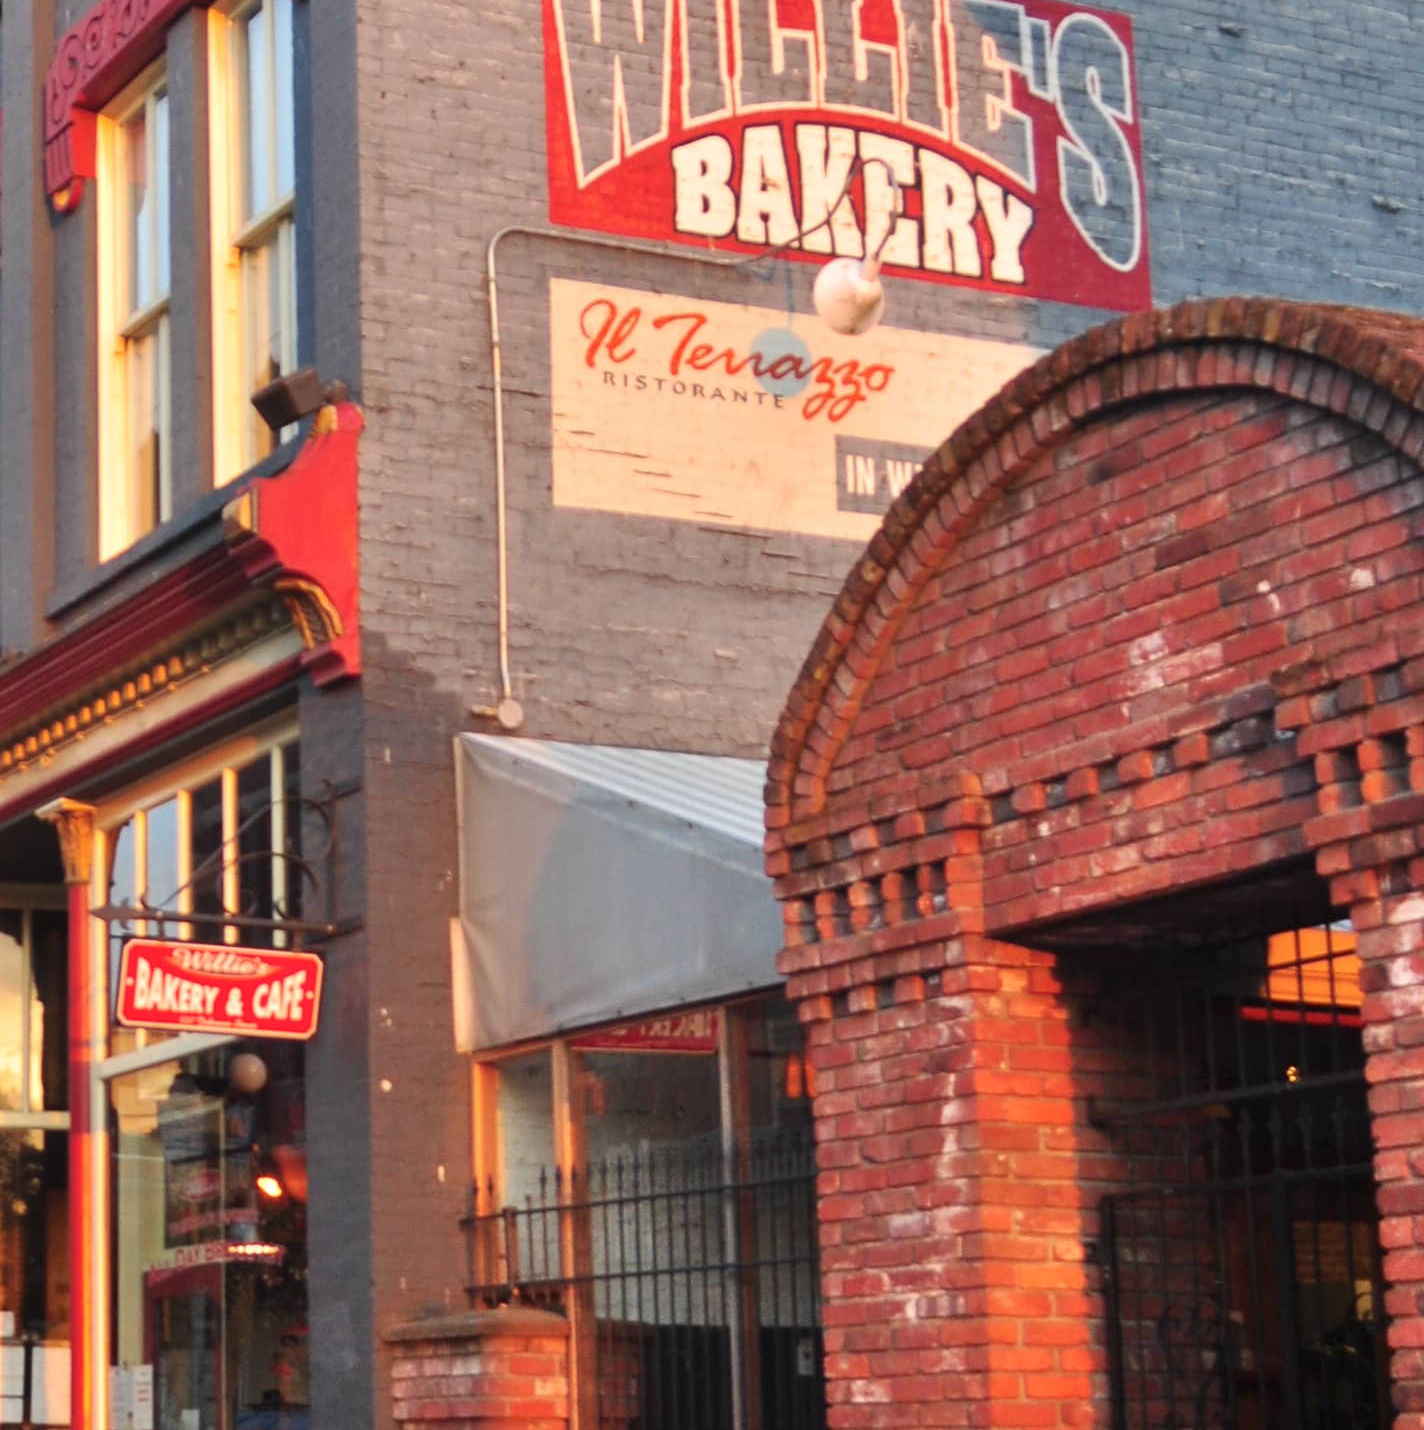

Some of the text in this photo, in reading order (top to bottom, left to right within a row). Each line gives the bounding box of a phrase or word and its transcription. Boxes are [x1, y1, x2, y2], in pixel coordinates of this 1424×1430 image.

[671, 123, 1034, 285] BAKERY
[579, 298, 895, 423] Il Terrazzo
[602, 370, 785, 410] RISTORANTE
[845, 454, 924, 498] IN W
[134, 957, 220, 1015] BAKERY
[226, 987, 244, 1017] &
[172, 947, 270, 976] Willie's
